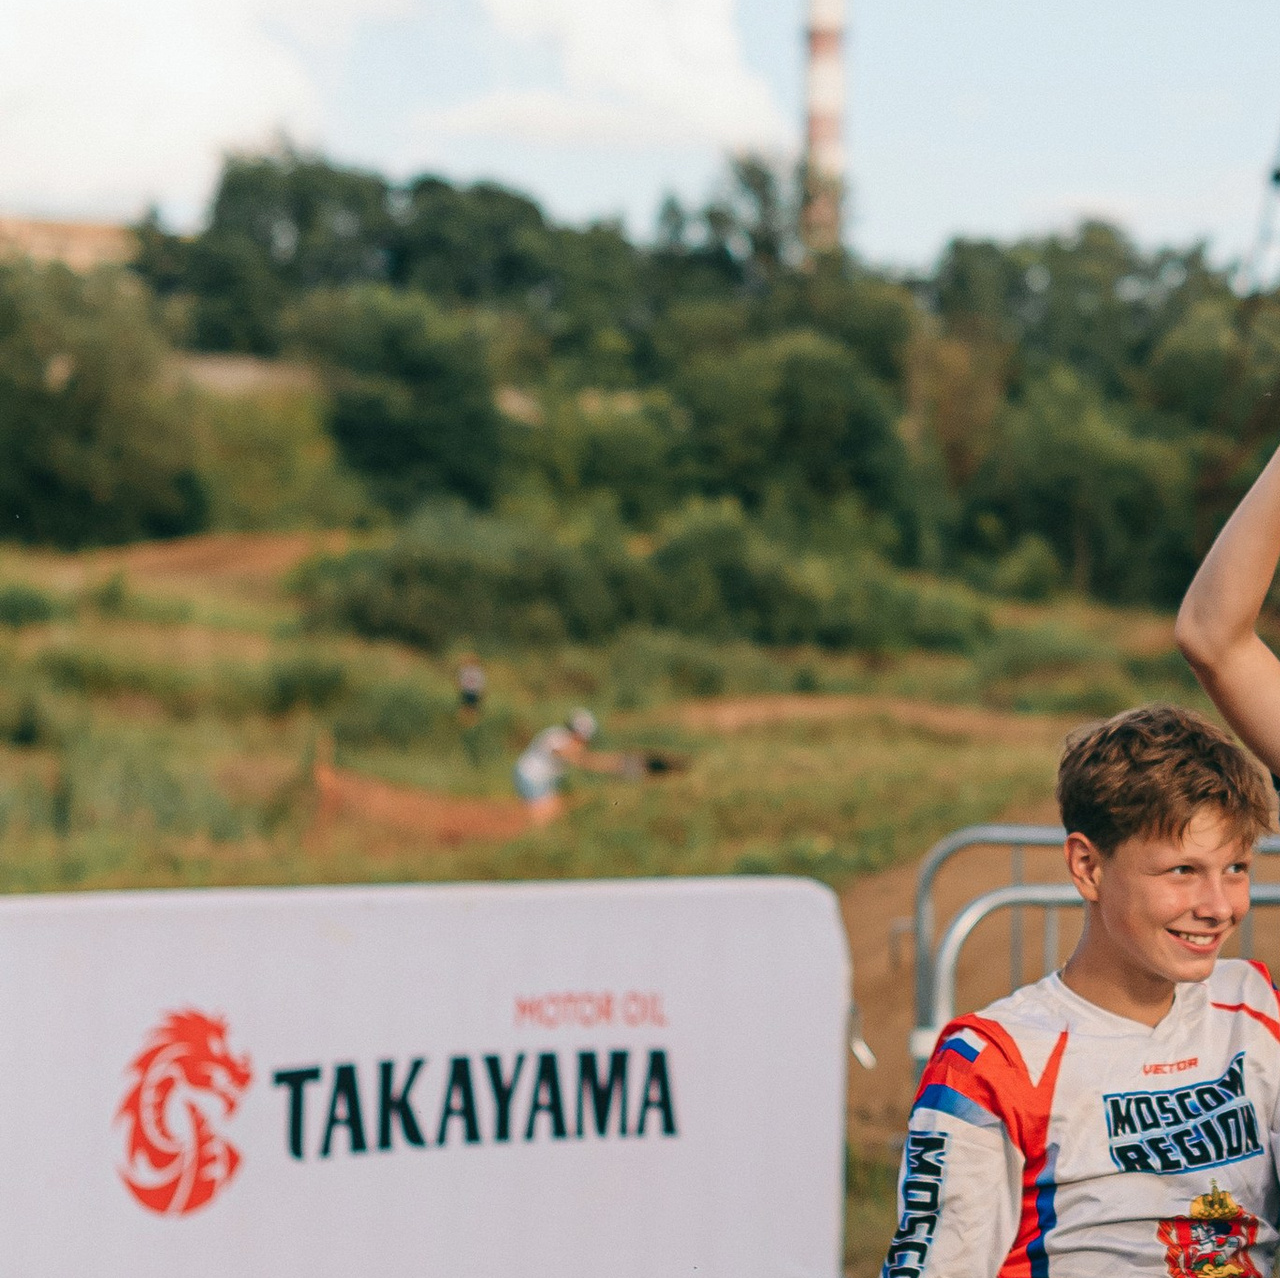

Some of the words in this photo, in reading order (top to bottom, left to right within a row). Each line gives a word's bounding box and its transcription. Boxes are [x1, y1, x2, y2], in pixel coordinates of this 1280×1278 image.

[514, 990, 614, 1030] MOTOR
[623, 988, 669, 1028] OIL
[272, 1048, 679, 1161] TAKAYAMA
[1108, 1055, 1246, 1138] MOSCOW
[1113, 1103, 1261, 1172] REGION
